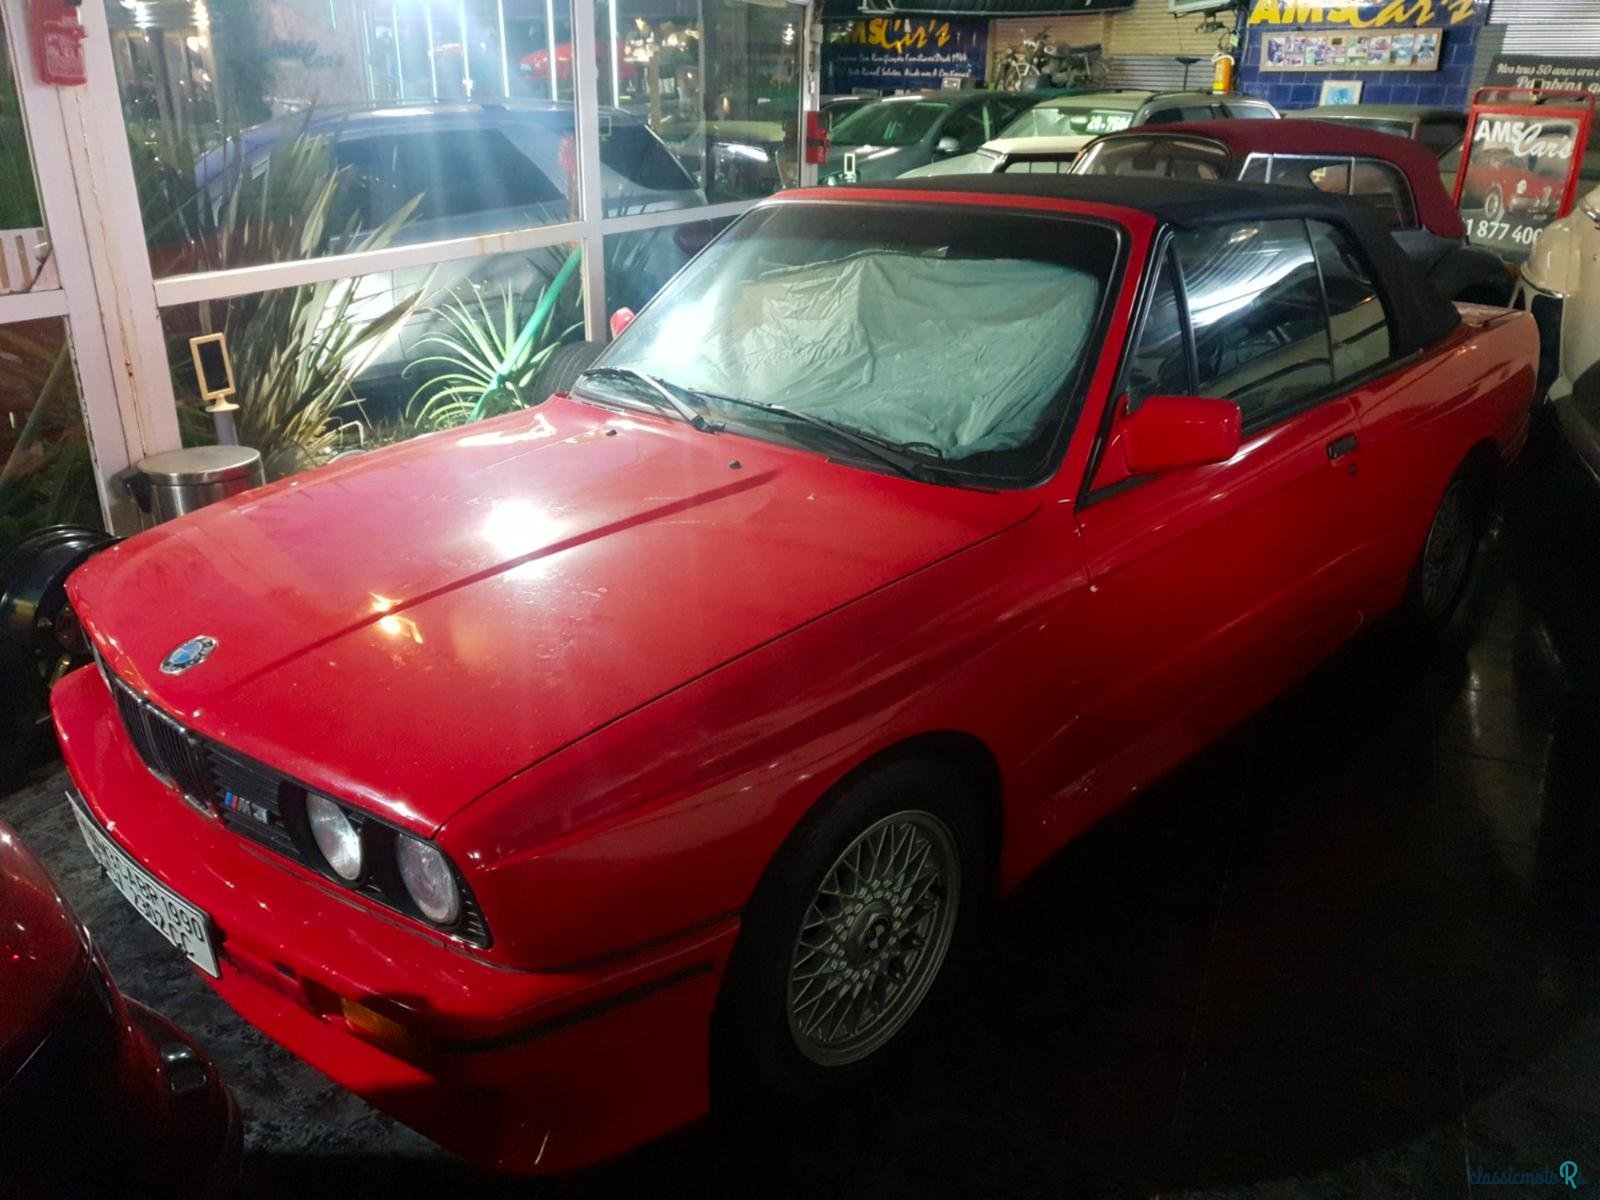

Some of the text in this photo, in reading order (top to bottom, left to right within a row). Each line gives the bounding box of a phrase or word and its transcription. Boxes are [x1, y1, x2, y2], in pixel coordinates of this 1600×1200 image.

[1536, 65, 1553, 75] 50
[1516, 75, 1583, 92] Paabéns
[1477, 220, 1510, 241] 877
[160, 895, 205, 943] 1990
